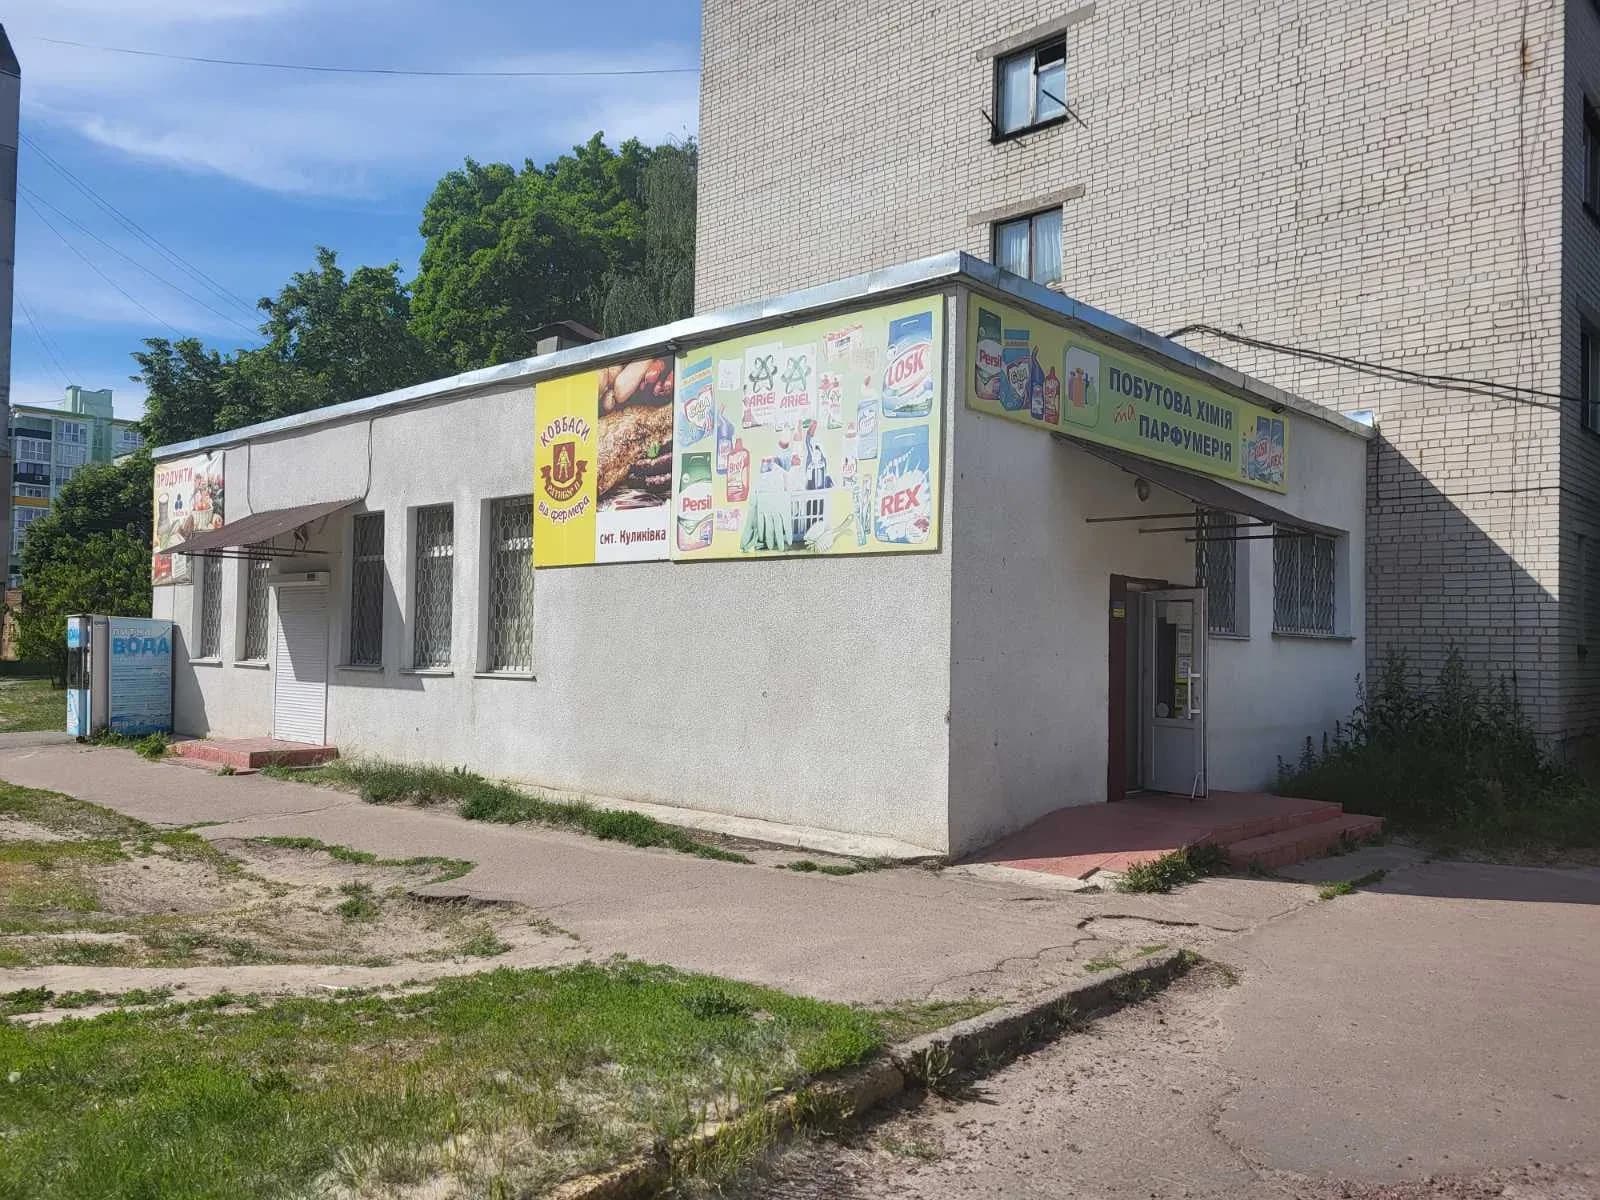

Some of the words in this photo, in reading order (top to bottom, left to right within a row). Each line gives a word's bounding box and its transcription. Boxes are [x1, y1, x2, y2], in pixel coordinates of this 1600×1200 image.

[888, 349, 925, 386] LOSK
[980, 350, 1002, 367] Persil
[1109, 367, 1192, 417] ПОБУТОВА
[1196, 400, 1233, 431] ХІМІЯ
[541, 416, 591, 447] КОВБАСИ
[1139, 414, 1232, 462] ПАРФУМЕРІЯ
[157, 467, 193, 489] ПРОДУКТИ
[539, 502, 550, 517] від
[551, 496, 591, 523] фермера
[682, 495, 713, 512] Persil
[881, 484, 922, 516] REX
[600, 532, 617, 545] смт.
[620, 528, 667, 545] Куликівка
[112, 636, 170, 656] ВОДА
